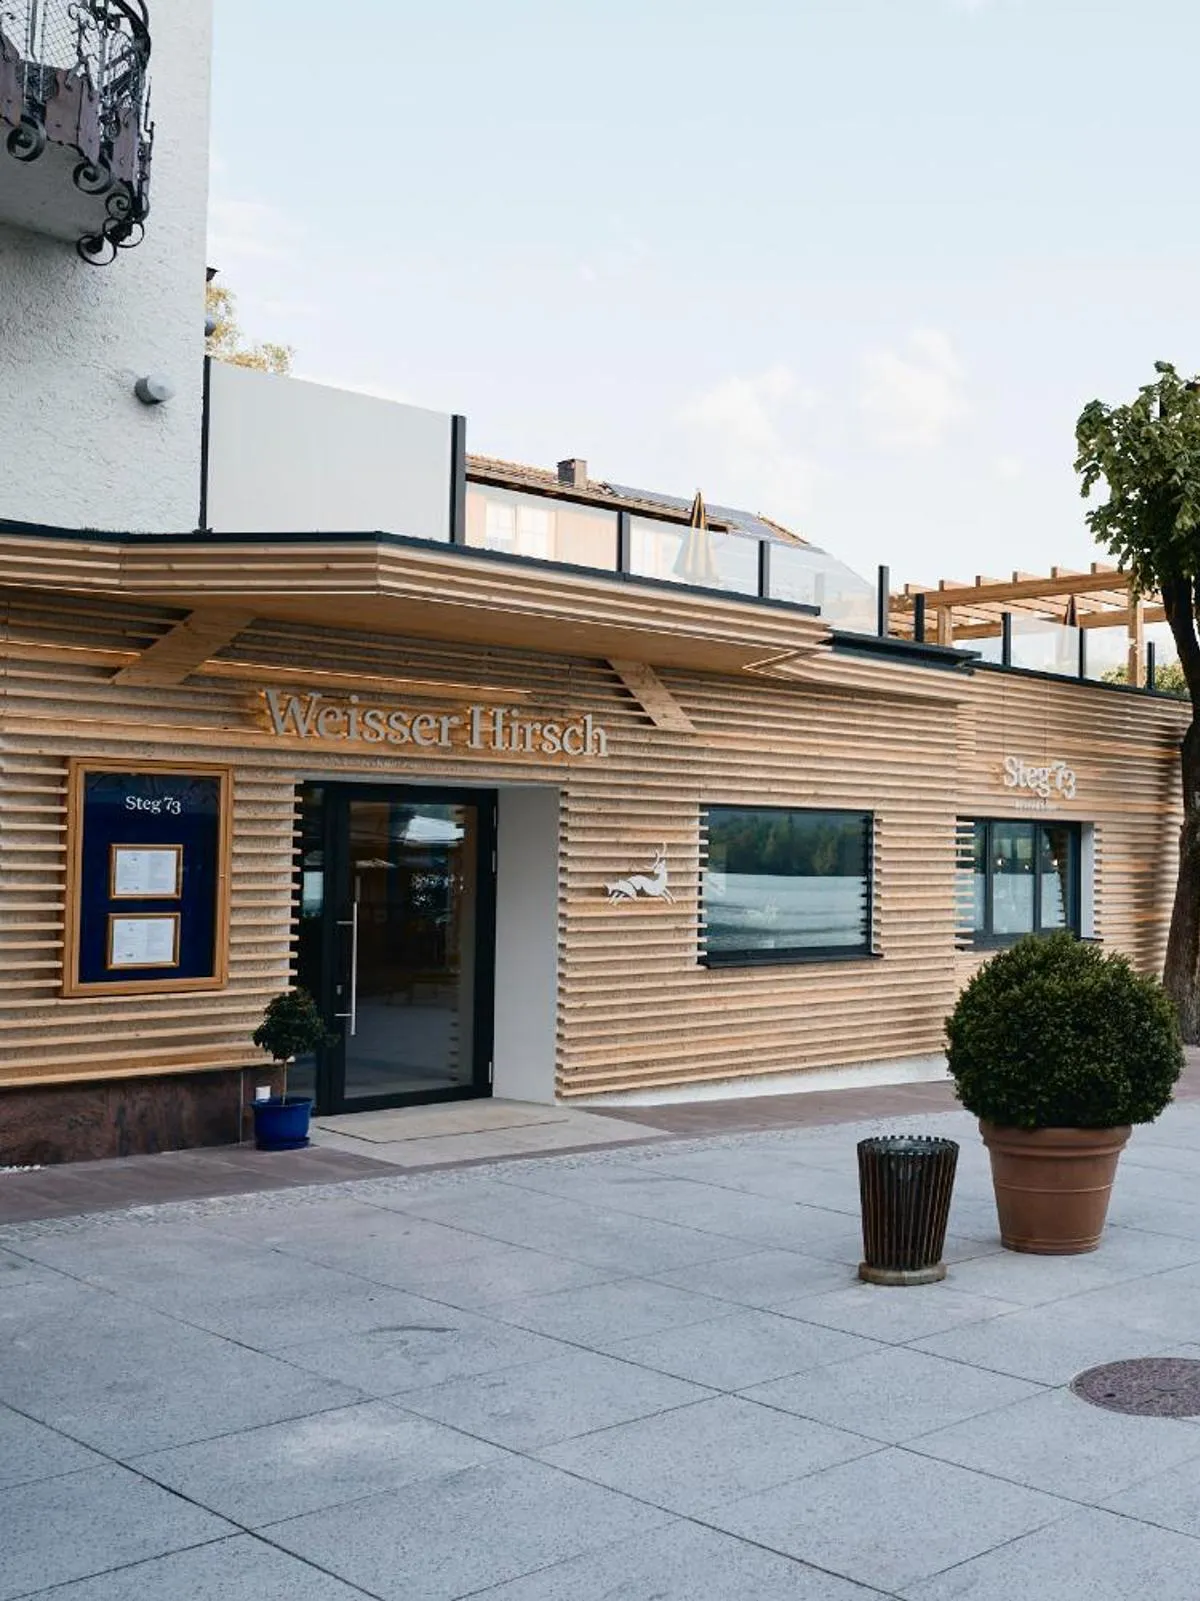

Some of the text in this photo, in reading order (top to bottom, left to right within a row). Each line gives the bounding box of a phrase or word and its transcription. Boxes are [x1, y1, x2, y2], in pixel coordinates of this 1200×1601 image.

[259, 687, 608, 757] Weisser Hirsch
[1003, 756, 1076, 800] Steg 73
[125, 795, 181, 815] Steg 73
